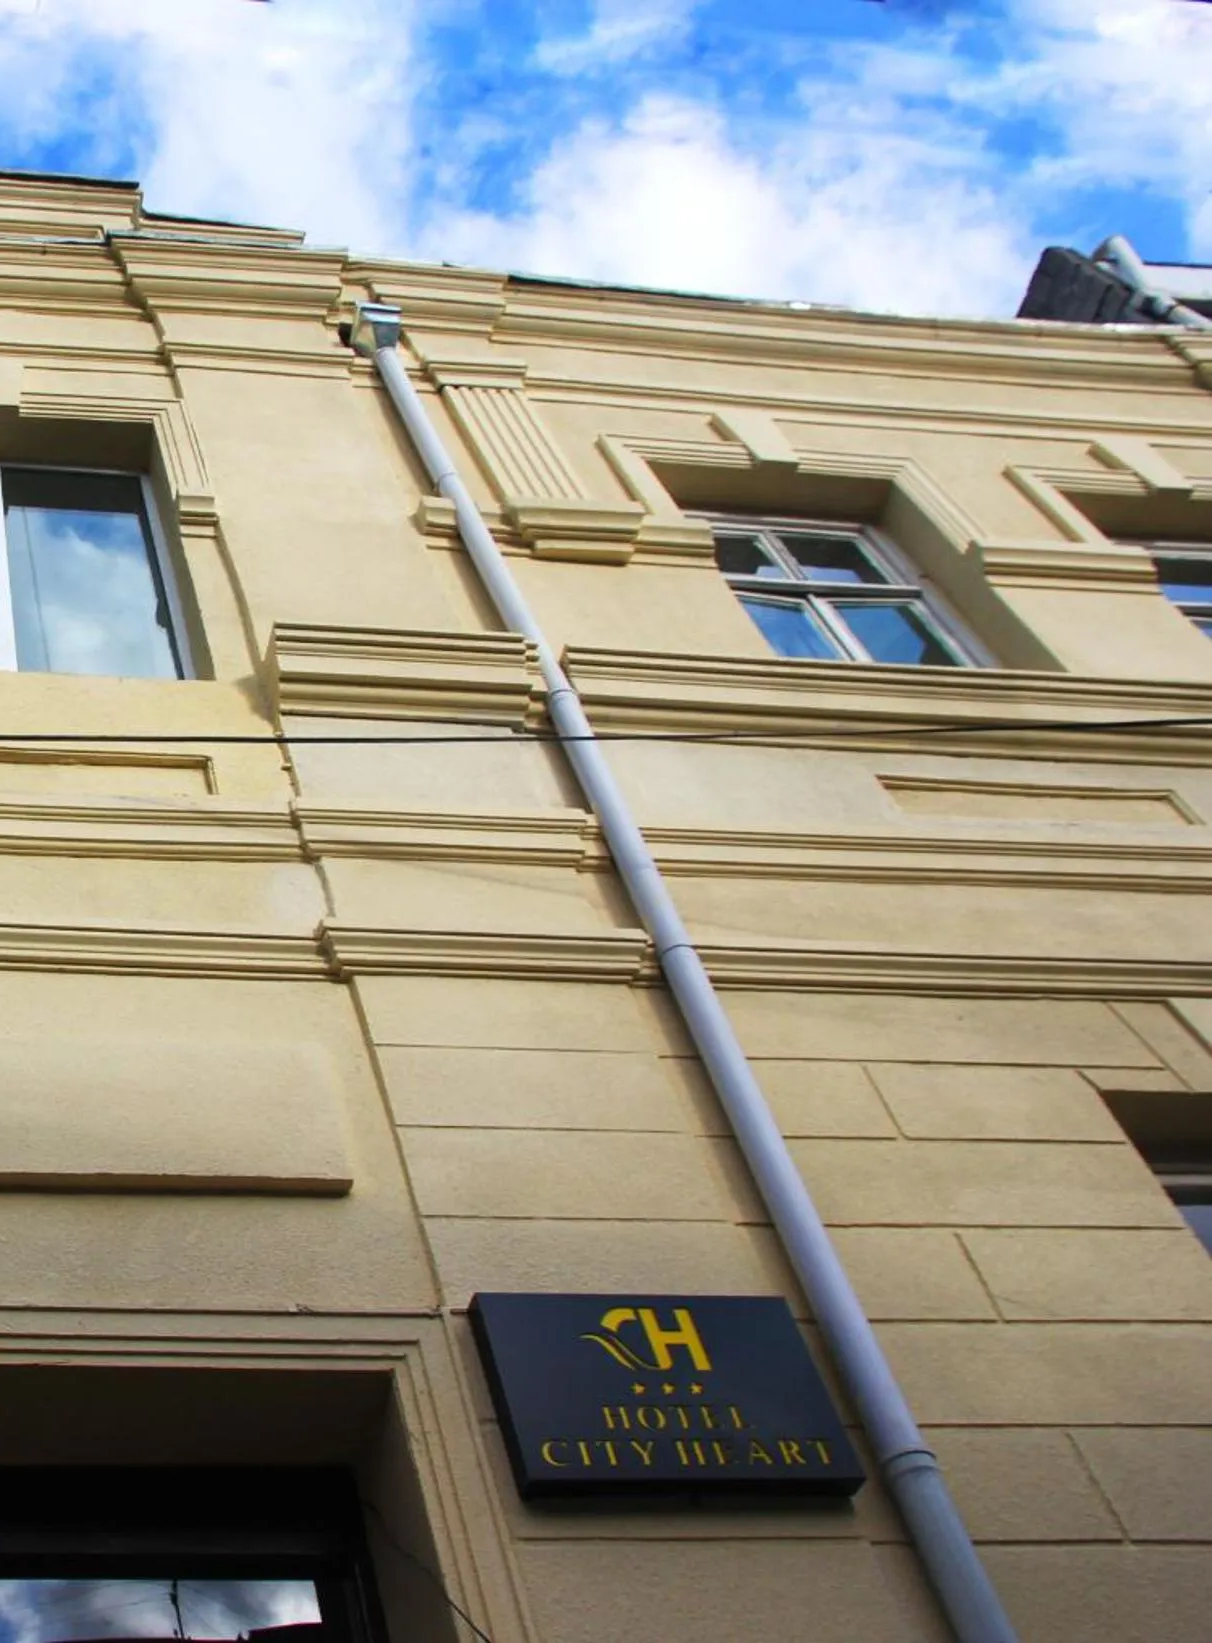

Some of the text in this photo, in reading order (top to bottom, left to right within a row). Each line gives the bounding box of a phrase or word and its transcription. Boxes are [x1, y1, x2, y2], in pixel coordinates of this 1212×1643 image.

[601, 1404, 756, 1431] HOTEL
[540, 1439, 832, 1467] CITY HEART
